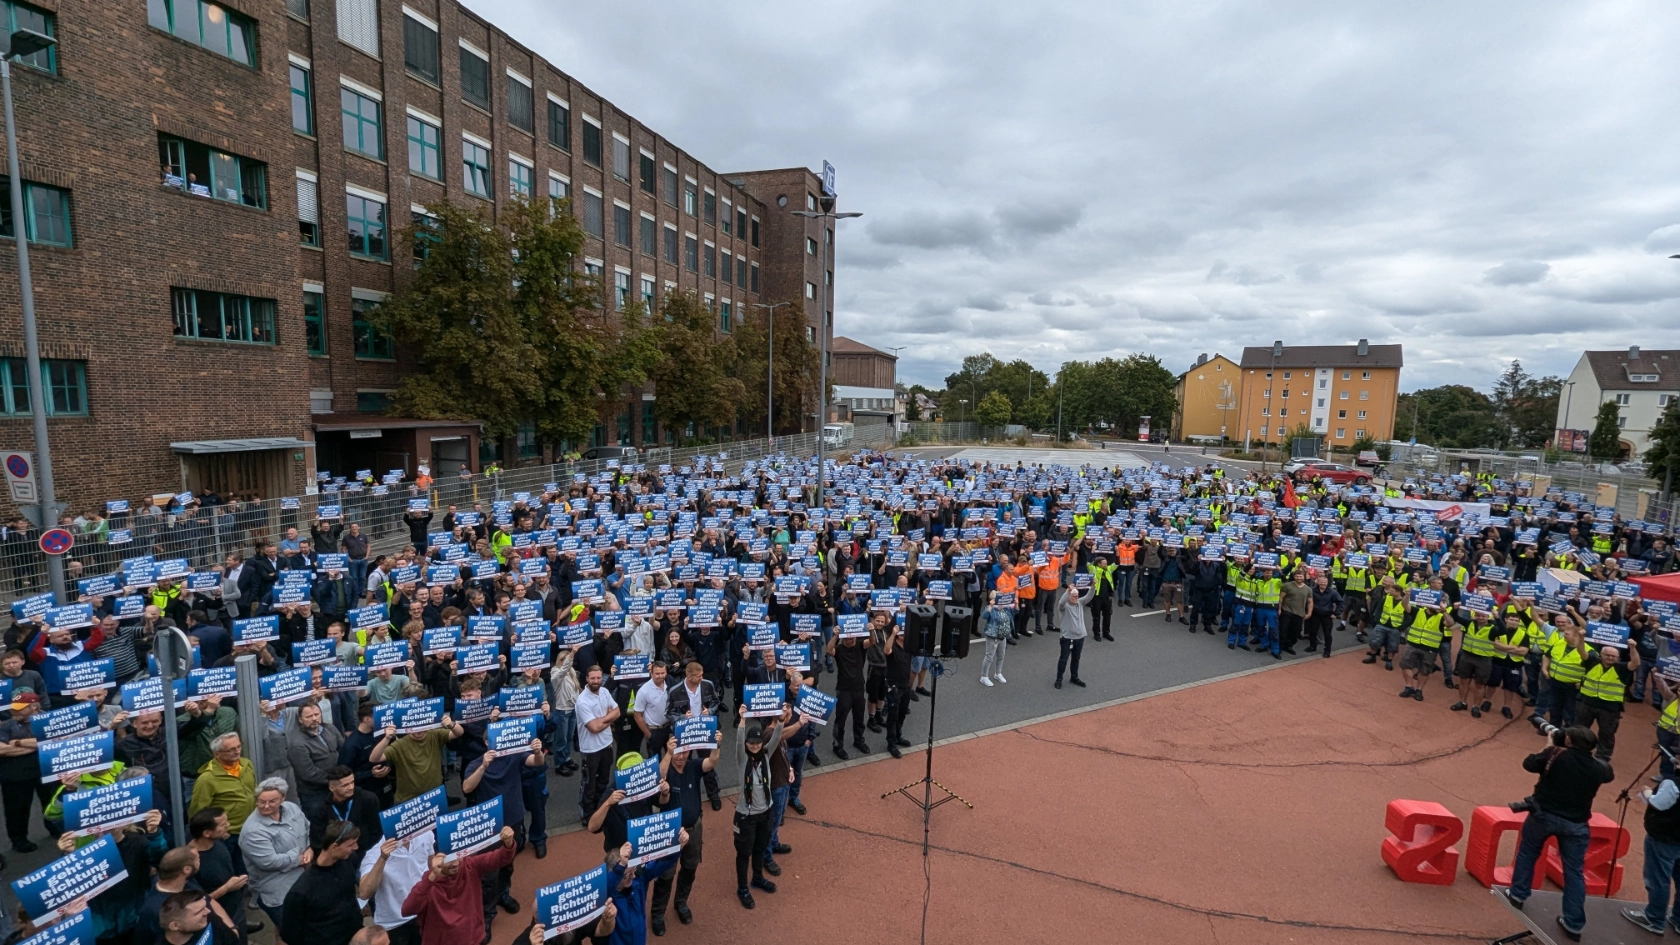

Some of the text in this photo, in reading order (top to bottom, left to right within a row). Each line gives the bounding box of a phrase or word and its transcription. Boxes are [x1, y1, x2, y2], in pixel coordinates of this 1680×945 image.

[826, 168, 834, 191] ZF
[464, 654, 493, 662] Richtung
[65, 672, 106, 683] Richtung
[71, 668, 98, 677] geht's
[271, 680, 306, 693] Richtung
[276, 676, 299, 687] geht's
[33, 713, 50, 721] Nur
[54, 708, 70, 716] mit
[50, 713, 80, 725] geht's
[402, 712, 436, 721] Richtung
[408, 707, 431, 715] geht's
[44, 717, 89, 732] Richtung
[502, 726, 525, 736] geht's
[681, 729, 711, 737] Richtung
[685, 723, 705, 731] geht's
[43, 733, 108, 751] Nur mit uns
[497, 732, 530, 742] Richtung
[52, 749, 102, 764] Richtung
[60, 743, 94, 756] geht's
[52, 756, 99, 772] Zukunft!
[618, 758, 658, 777] Nur mit uns
[626, 773, 658, 789] Richtung
[631, 768, 652, 781] geht's
[68, 778, 145, 801] Nur mit uns
[627, 780, 656, 796] Zukunft!
[80, 797, 140, 817] Richtung
[89, 791, 130, 808] geht's
[383, 789, 440, 818] Nur mit uns
[81, 806, 136, 827] Zukunft!
[395, 806, 439, 830] Richtung
[401, 802, 431, 821] geht's
[440, 800, 498, 824] Nur mit uns
[631, 811, 679, 828] Nur mit uns
[397, 814, 437, 838] Zukunft!
[451, 819, 496, 841] Richtung
[458, 814, 488, 831] geht's
[645, 822, 669, 836] geht's
[451, 828, 493, 851] Zukunft!
[639, 830, 674, 845] Richtung
[639, 838, 671, 854] Zukunft!
[17, 839, 107, 888] Nur mit uns
[41, 860, 109, 900] Richtung
[48, 858, 94, 887] geht's
[45, 870, 109, 909] Zukunft!
[541, 869, 603, 897] Nur mit uns
[551, 890, 599, 915] Richtung
[559, 884, 591, 904] geht's
[552, 900, 596, 925] Zukunft!
[54, 914, 84, 934] uns
